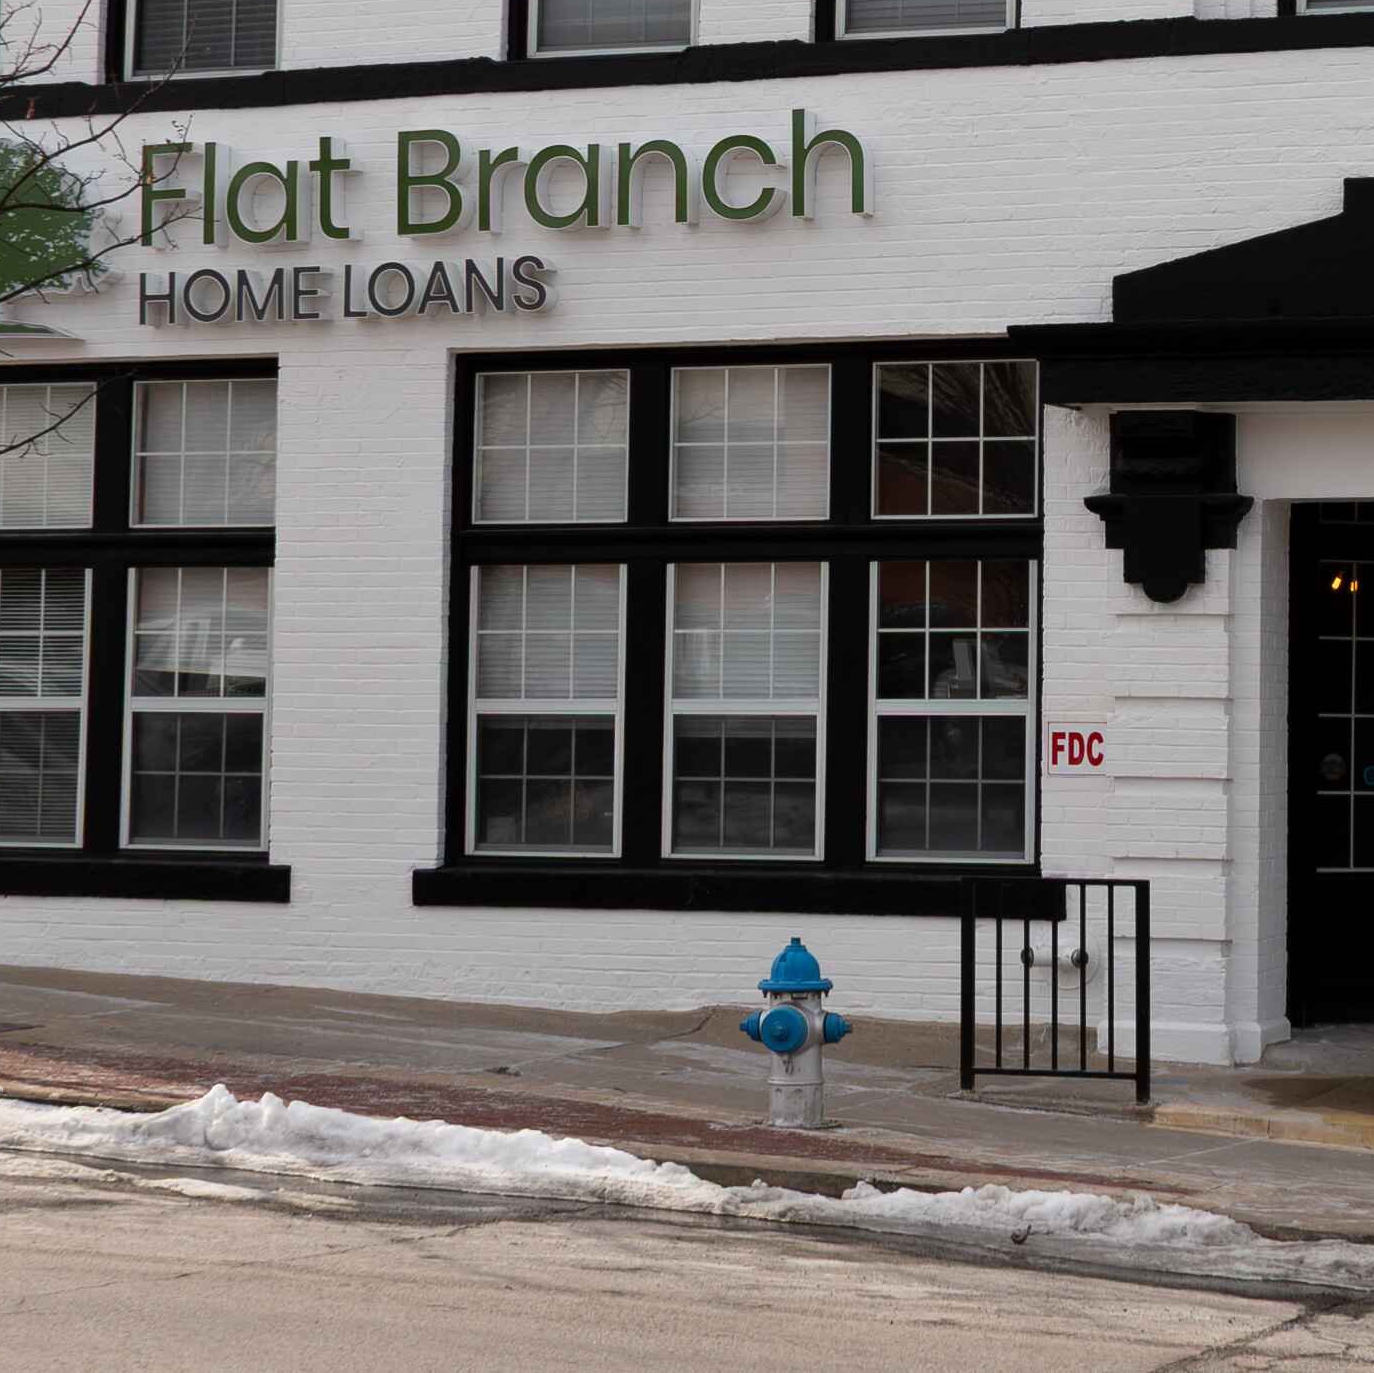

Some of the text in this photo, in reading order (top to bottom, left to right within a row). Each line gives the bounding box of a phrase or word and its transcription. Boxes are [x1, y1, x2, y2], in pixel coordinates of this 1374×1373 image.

[141, 108, 865, 247] Flat Branch
[139, 255, 548, 326] HOME LOANS
[1051, 731, 1105, 767] FDC
